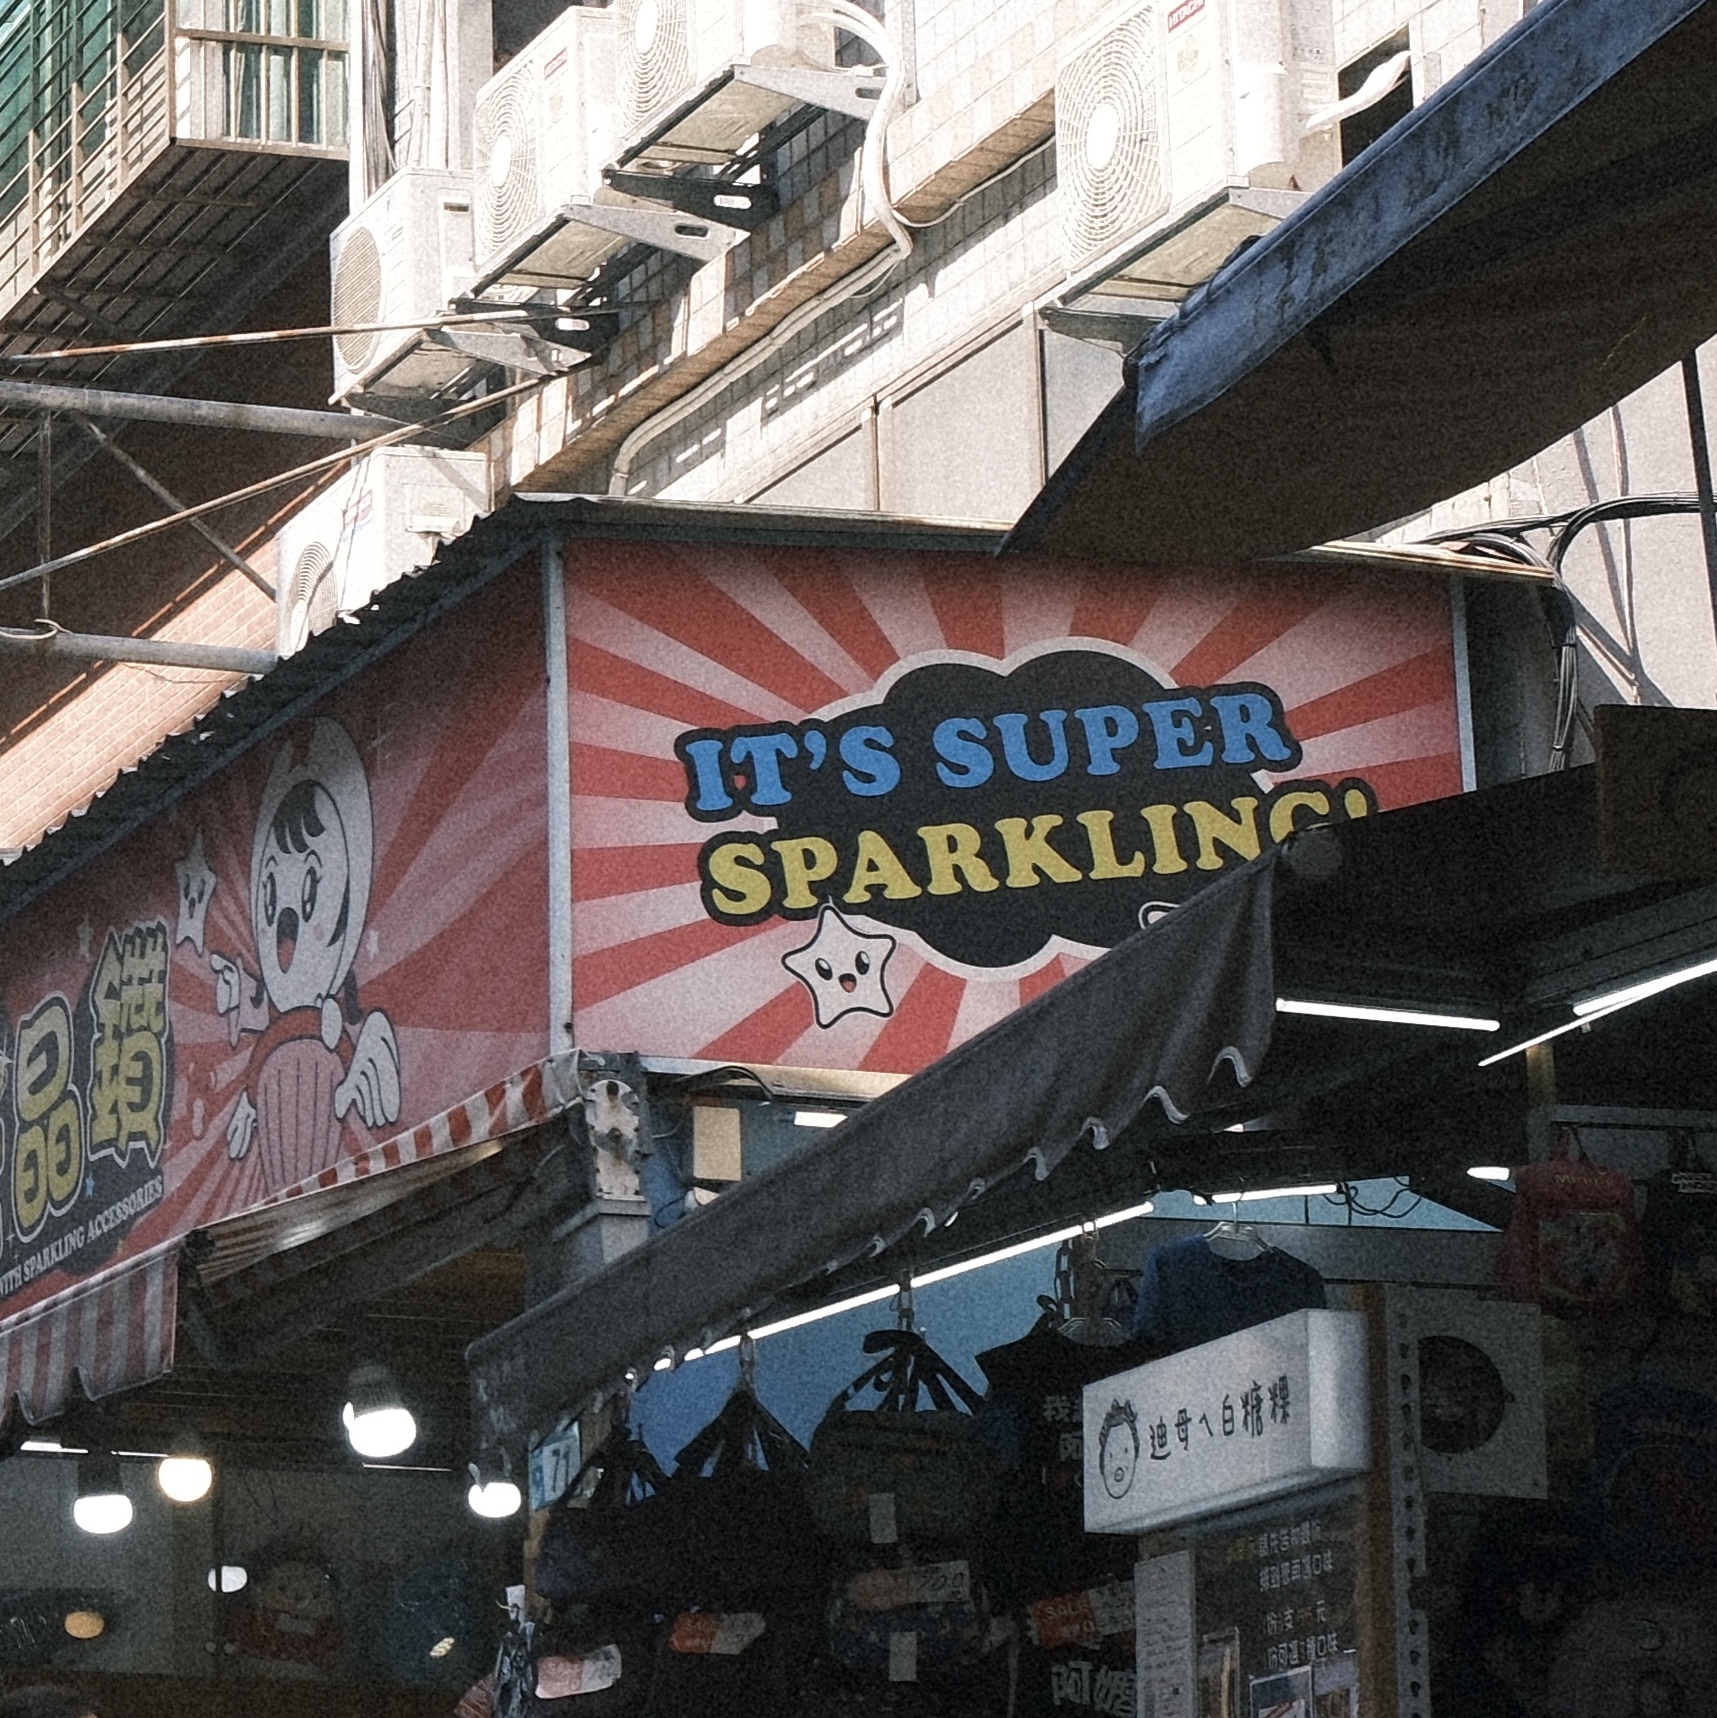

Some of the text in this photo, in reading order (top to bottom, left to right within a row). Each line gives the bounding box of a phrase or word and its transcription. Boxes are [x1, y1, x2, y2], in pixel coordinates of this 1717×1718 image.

[685, 690, 1292, 814] IT'S SUPER
[23, 1225, 85, 1283] SPARKLING
[86, 1175, 164, 1244] ACCESSORIES
[1148, 1375, 1292, 1463] 迪母ㄟ白糖粿
